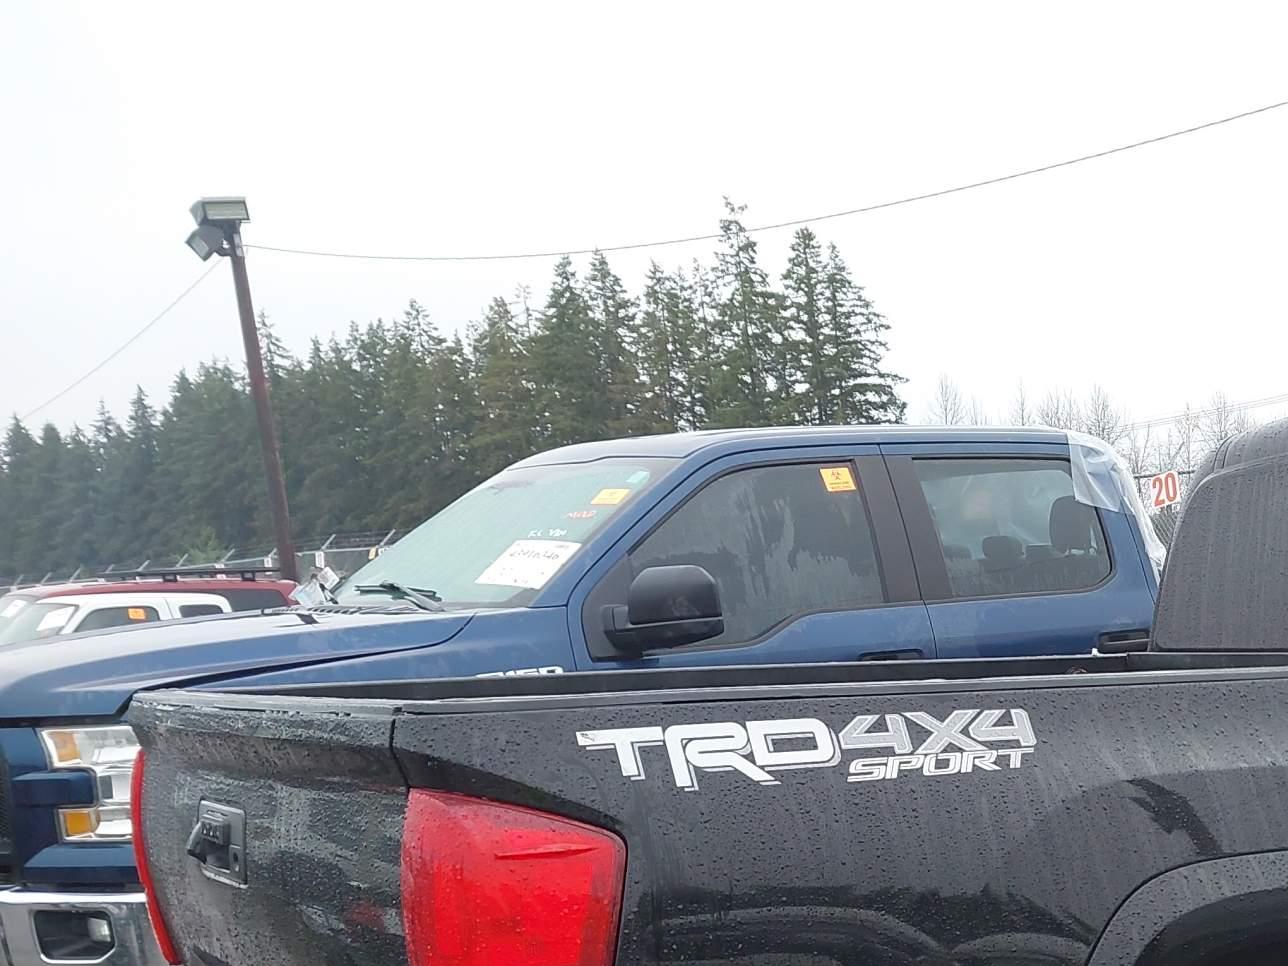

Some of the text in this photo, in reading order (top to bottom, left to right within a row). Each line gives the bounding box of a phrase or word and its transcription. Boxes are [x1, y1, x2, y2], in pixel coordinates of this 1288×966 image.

[1152, 472, 1177, 507] 20
[575, 717, 841, 791] TRD
[846, 747, 1035, 783] SPORT
